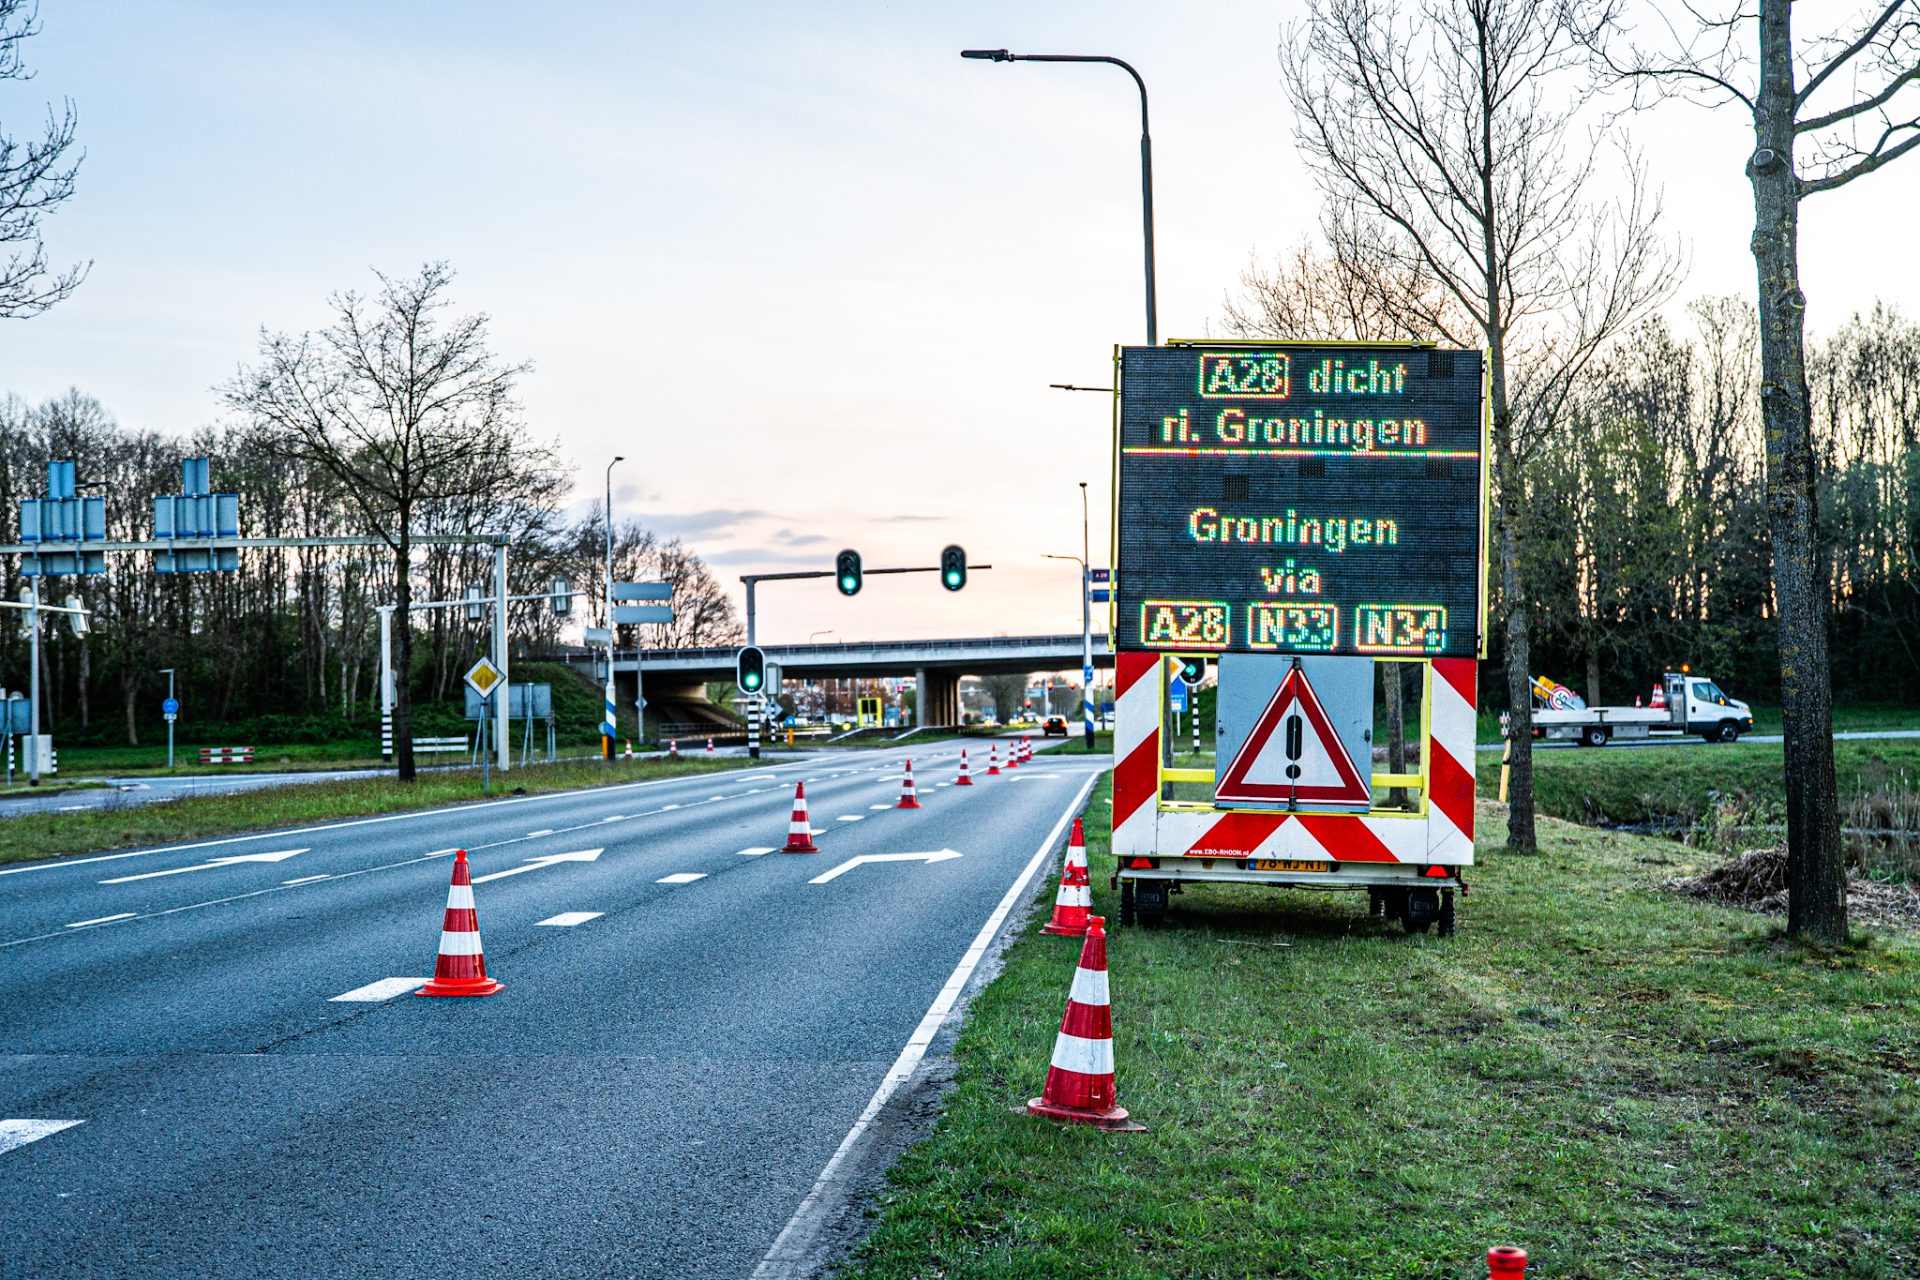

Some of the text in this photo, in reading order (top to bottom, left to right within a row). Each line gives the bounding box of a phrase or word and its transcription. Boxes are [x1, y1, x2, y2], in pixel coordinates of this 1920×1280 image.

[1207, 359, 1408, 393] A28 dicht
[1162, 408, 1426, 452] ri. Groningen
[1188, 507, 1398, 554] Groningen
[1260, 558, 1321, 594] via
[1149, 606, 1440, 646] A28 N33 N34
